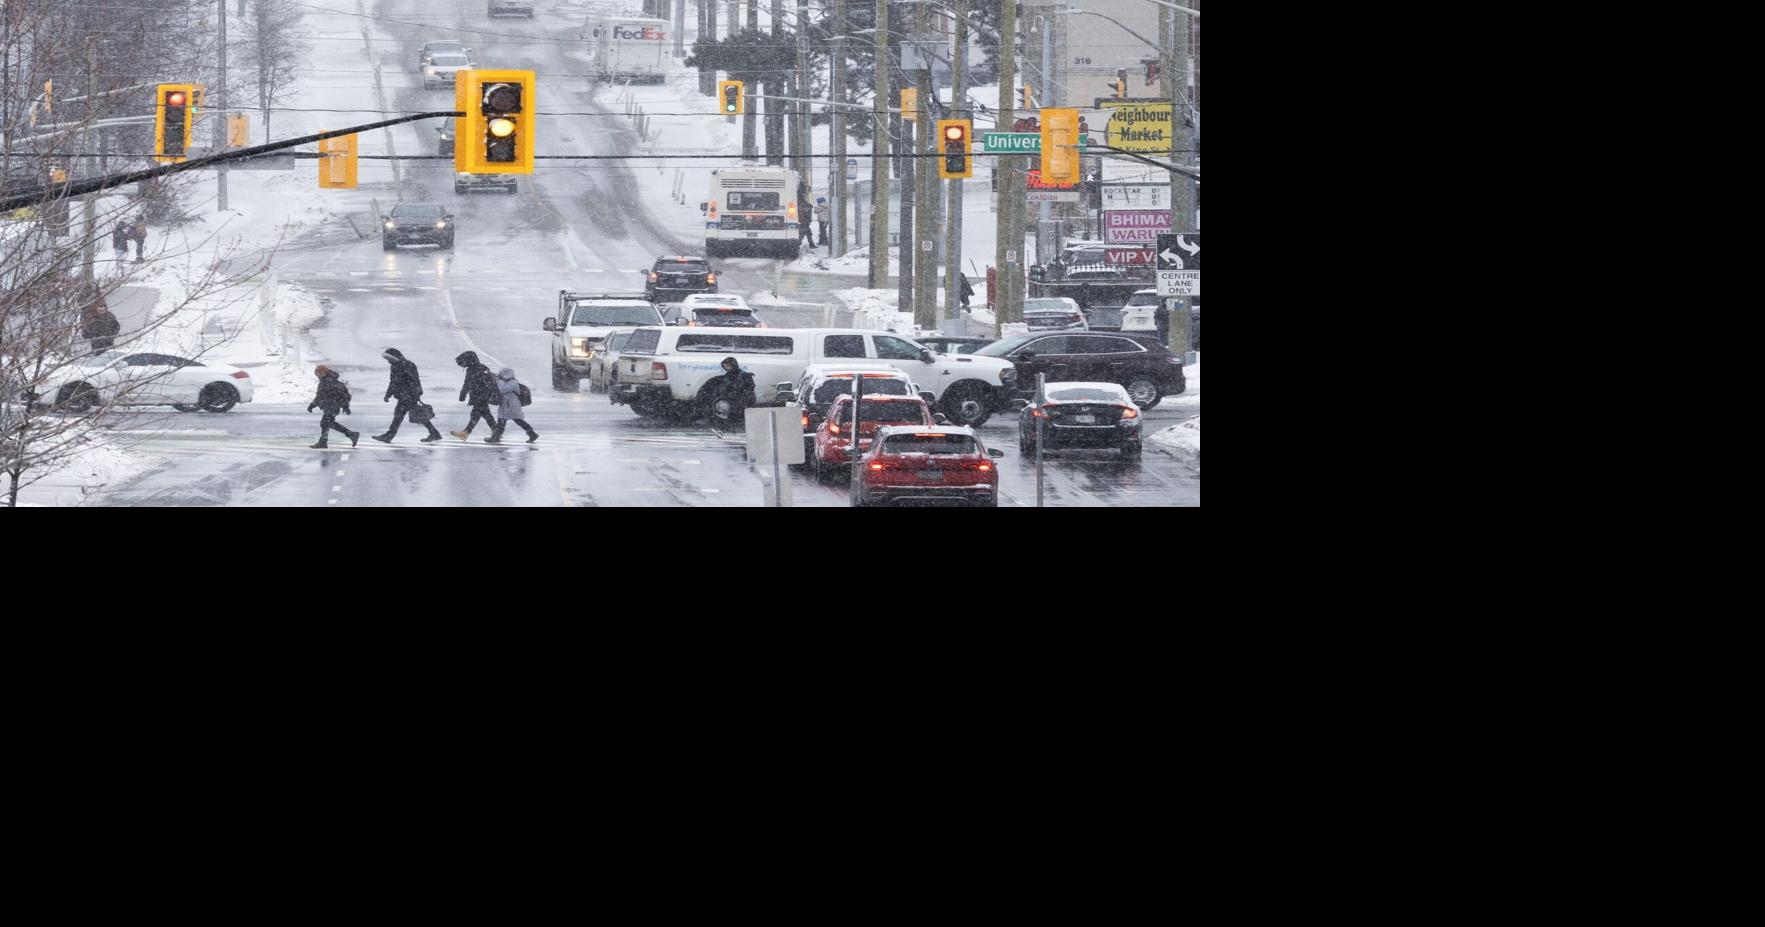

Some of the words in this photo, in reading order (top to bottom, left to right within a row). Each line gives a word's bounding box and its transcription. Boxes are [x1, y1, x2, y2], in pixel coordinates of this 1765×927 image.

[613, 26, 666, 40] FedEx
[1120, 127, 1163, 141] Market
[1112, 229, 1169, 240] WARU
[1108, 251, 1137, 263] VIP
[1168, 287, 1192, 295] ONLY
